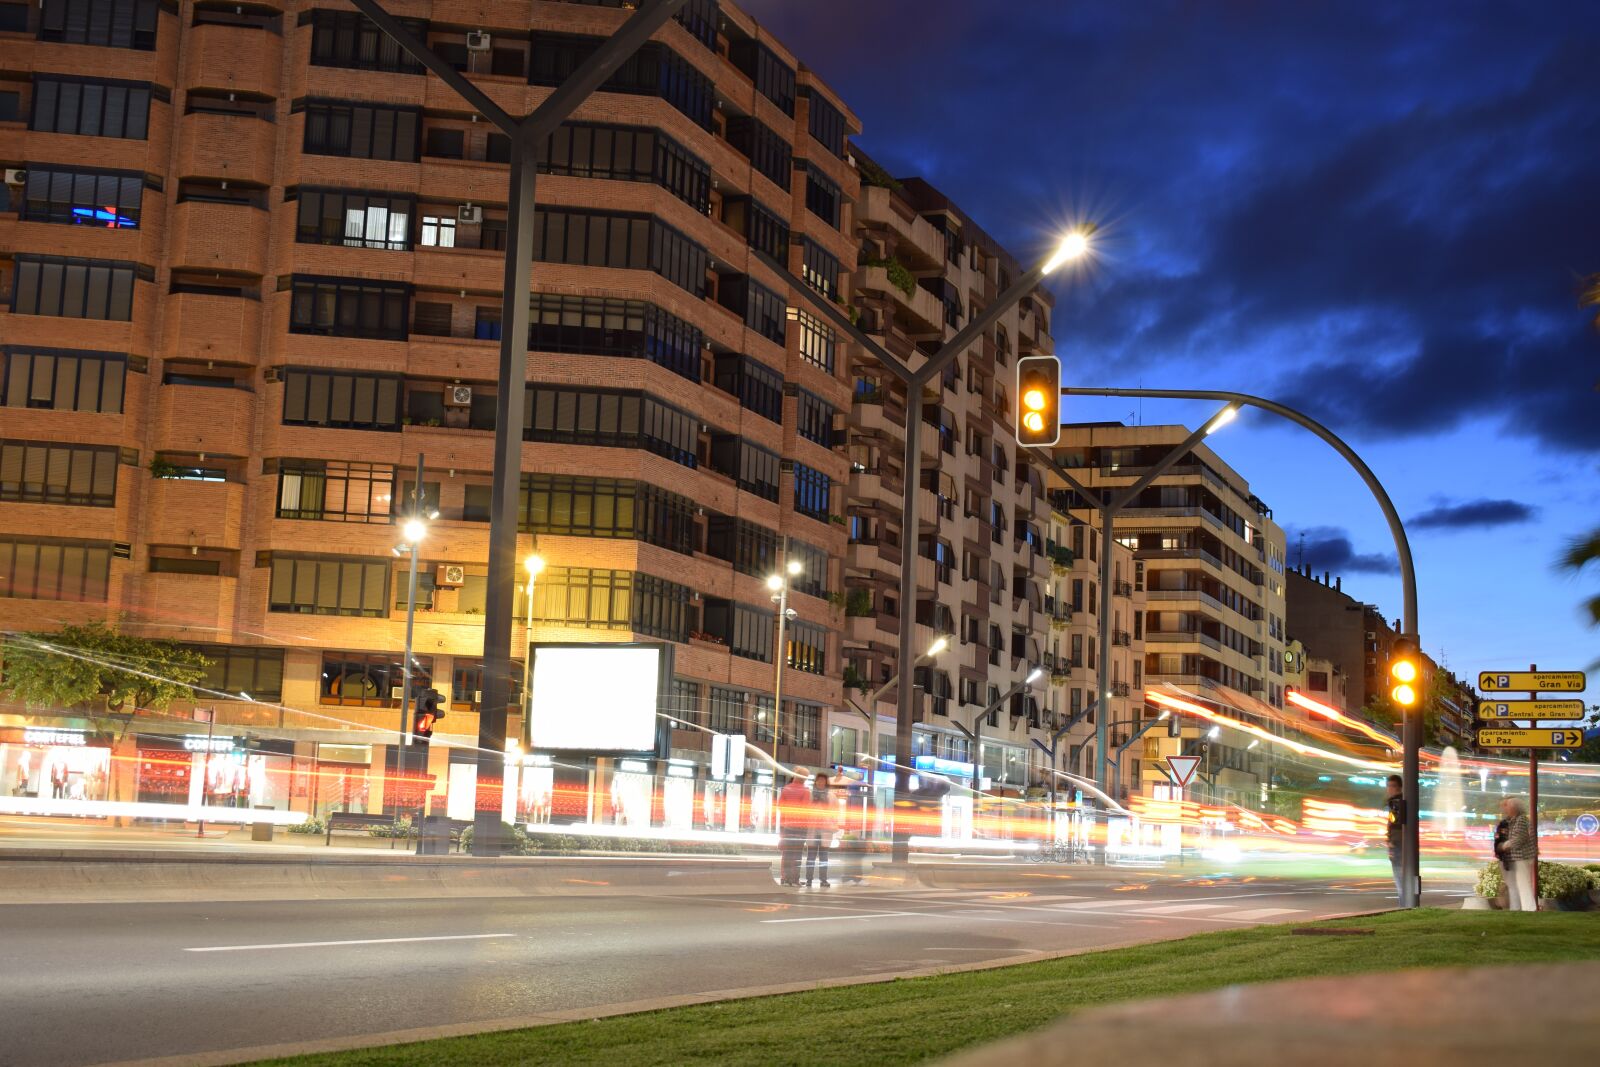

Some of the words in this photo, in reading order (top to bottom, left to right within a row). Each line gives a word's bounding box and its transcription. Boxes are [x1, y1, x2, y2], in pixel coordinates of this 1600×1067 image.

[1539, 680, 1561, 688] Gran
[1480, 736, 1491, 744] La
[1496, 736, 1512, 744] Paz
